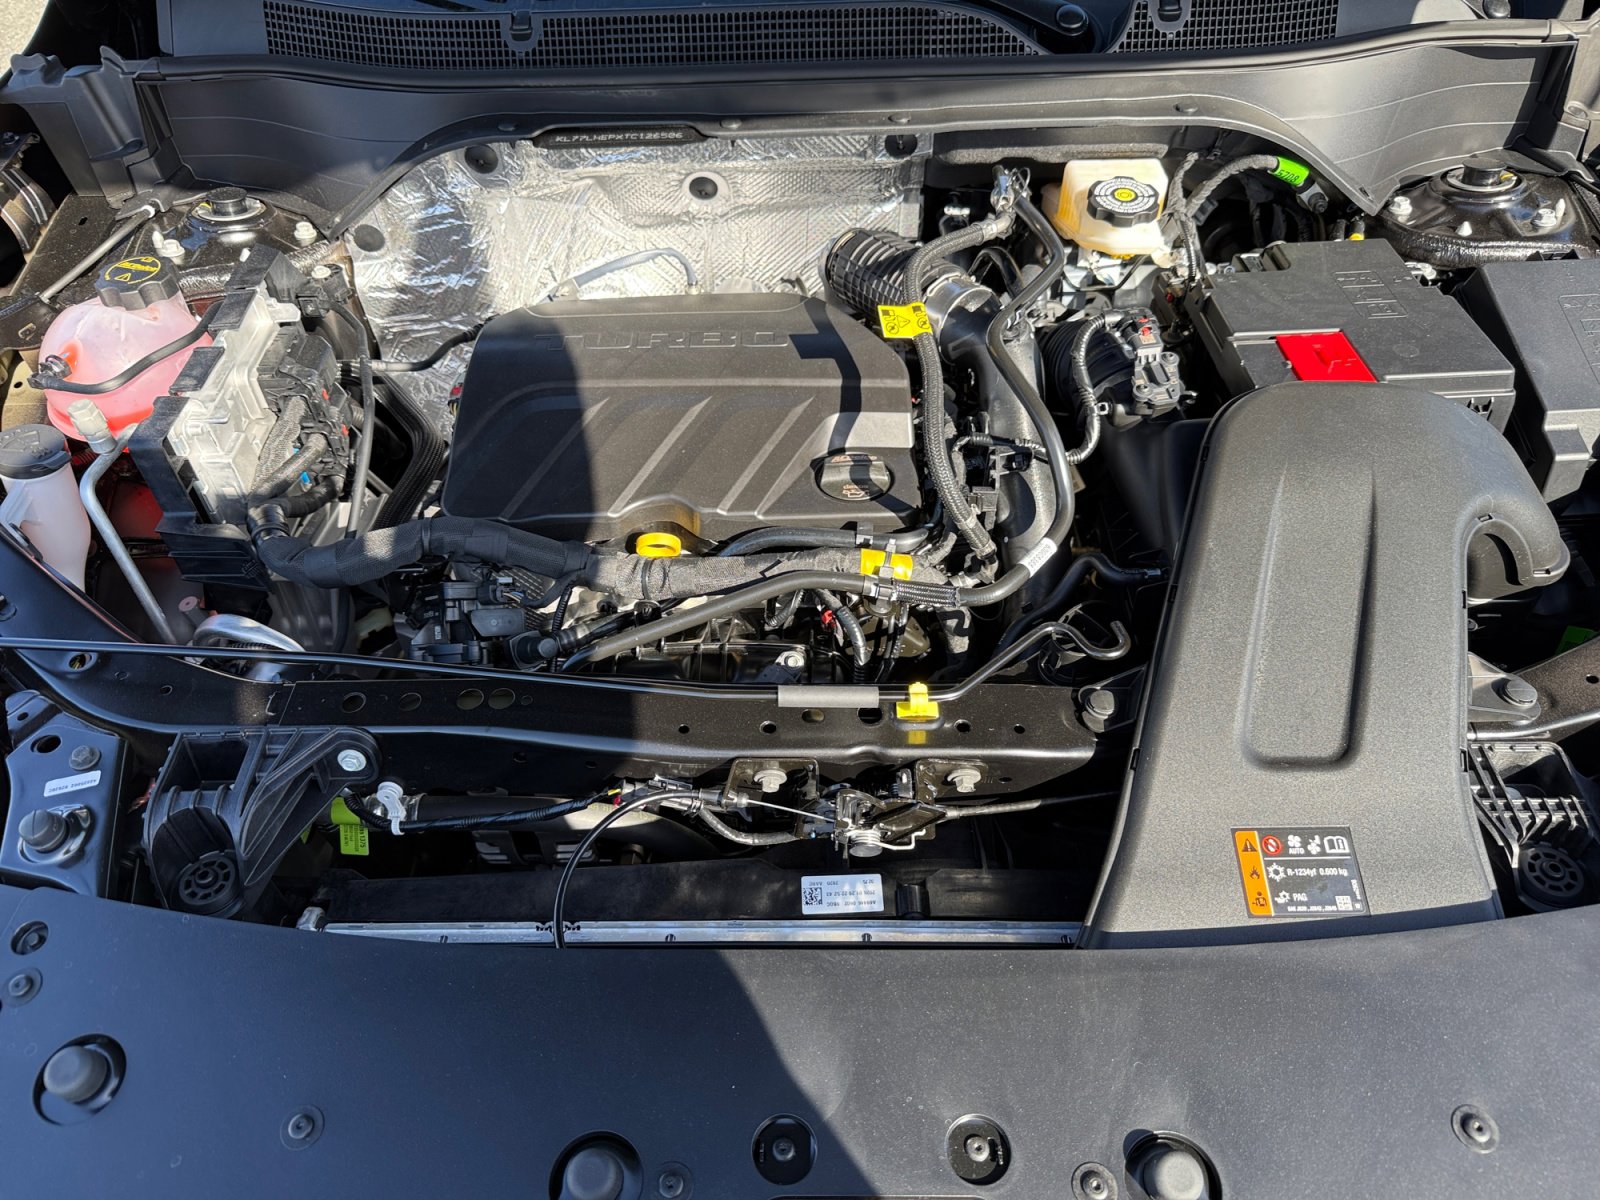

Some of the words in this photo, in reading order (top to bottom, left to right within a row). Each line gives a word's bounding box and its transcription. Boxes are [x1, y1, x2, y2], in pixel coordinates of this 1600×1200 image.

[534, 330, 790, 351] TURBO
[1288, 847, 1305, 855] AUTO
[1286, 867, 1317, 878] R-1234yf
[1338, 867, 1349, 878] kg
[1292, 892, 1308, 902] PAG
